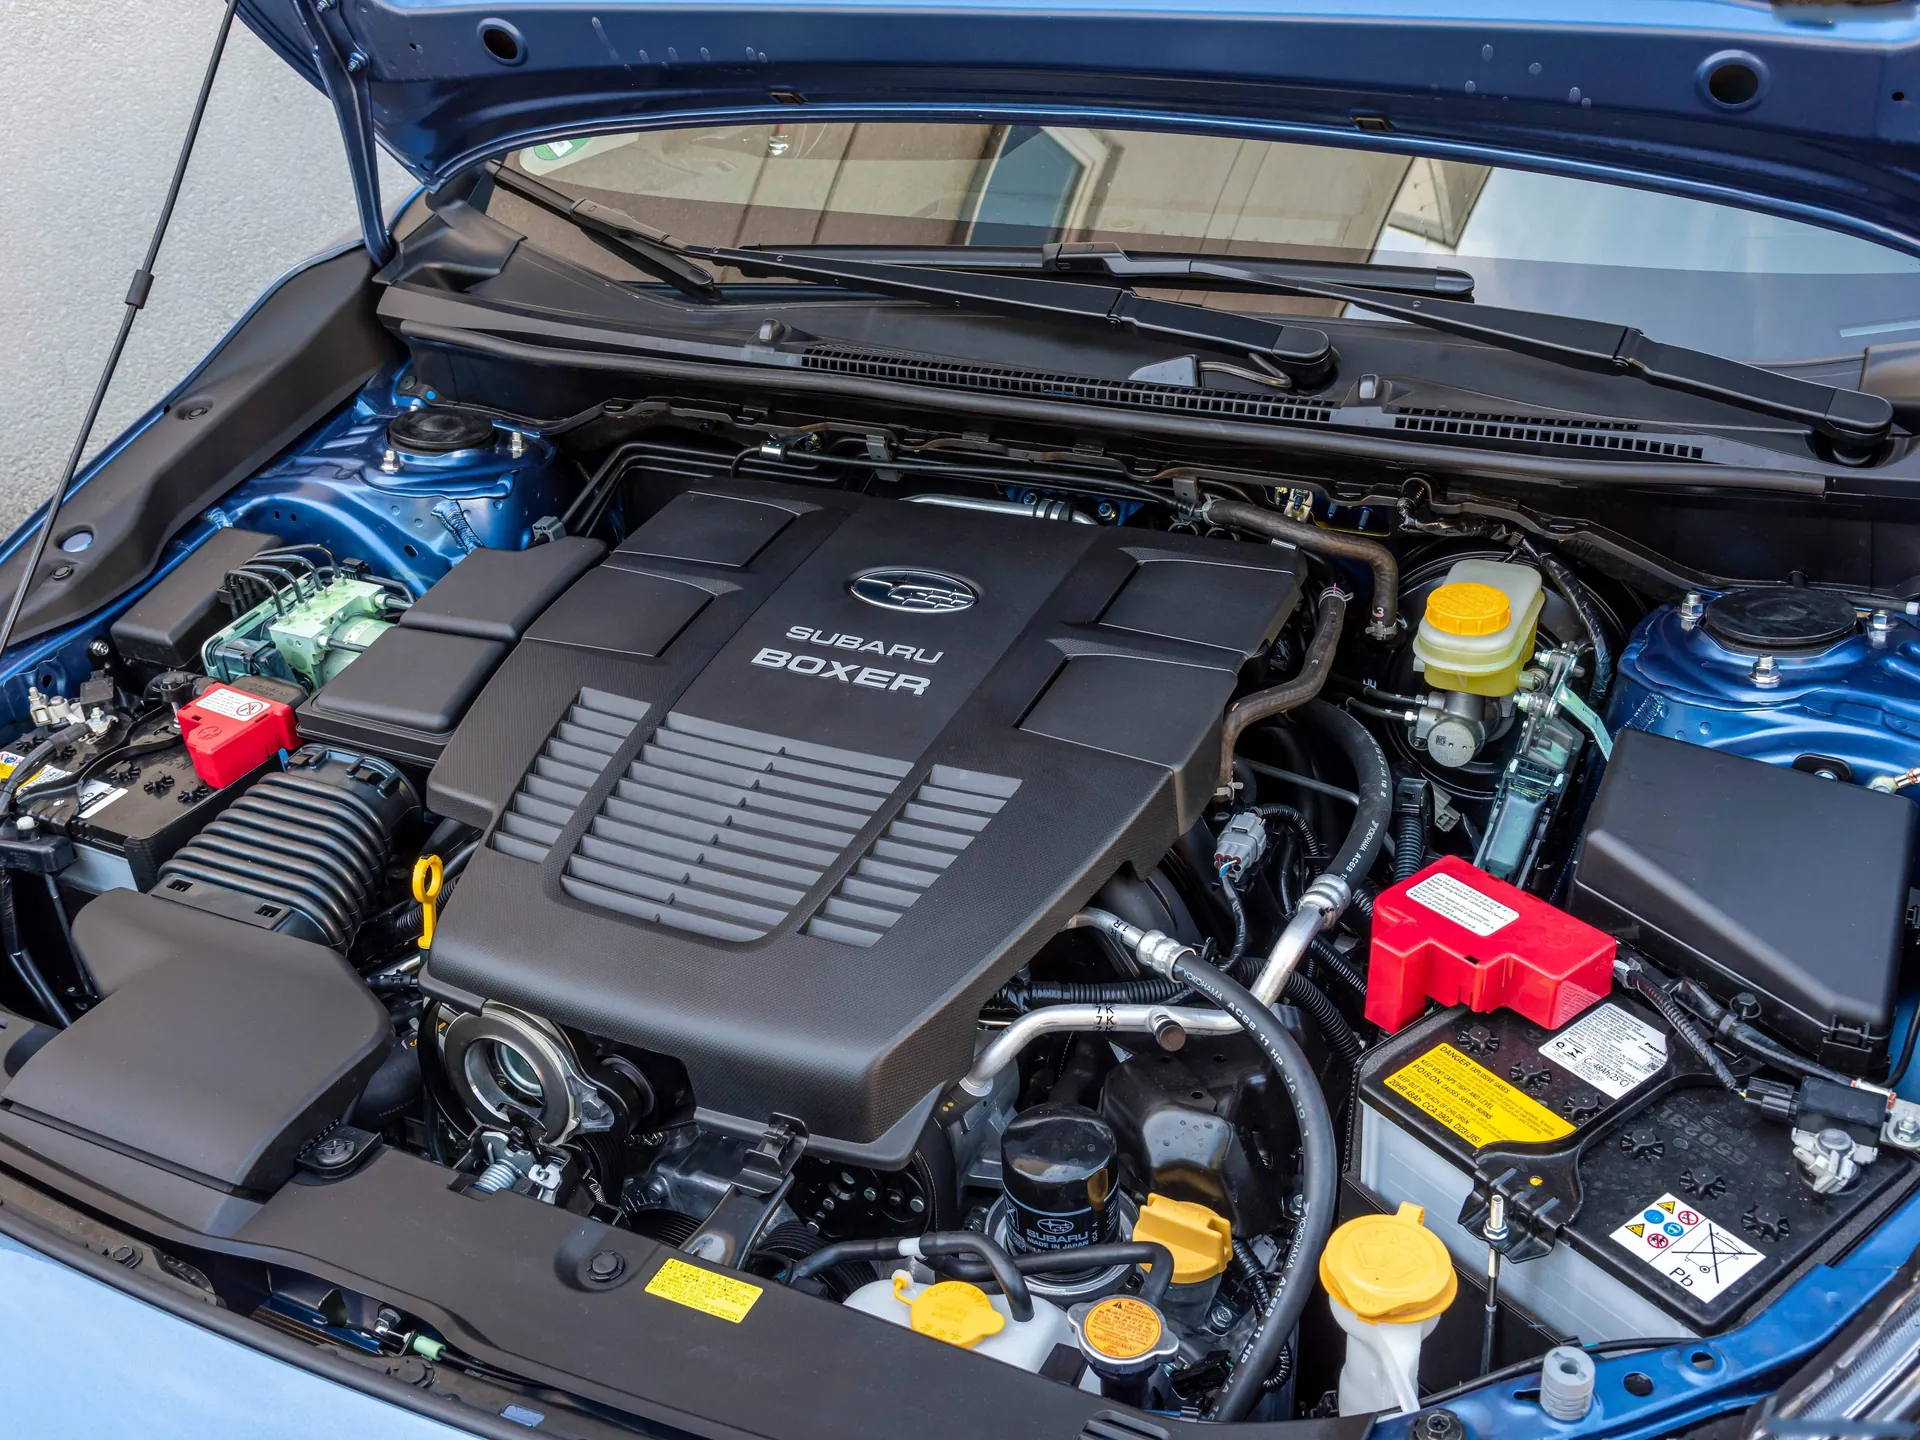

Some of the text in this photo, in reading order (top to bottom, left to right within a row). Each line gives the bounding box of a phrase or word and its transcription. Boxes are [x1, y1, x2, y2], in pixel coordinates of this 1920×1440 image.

[785, 625, 944, 664] SUBARU
[751, 648, 932, 696] BOXER
[1359, 825, 1377, 852] YOKOHAMA
[1345, 852, 1362, 873] AC6B
[1182, 969, 1224, 1001] YOKOHAMA
[1227, 1001, 1258, 1031] AC6B
[1259, 1033, 1271, 1047] 11
[1270, 1048, 1284, 1067] HP
[1284, 1073, 1297, 1094] JA
[1419, 1059, 1494, 1109] KEEP VENT CAPS TIGHT AND LEVEL
[1438, 1045, 1471, 1067] DANGER
[1469, 1066, 1495, 1083] EXPLOSIVE
[1492, 1081, 1510, 1093] GASES
[1387, 1078, 1407, 1092] 20HR
[1403, 1089, 1423, 1103] 48Ah
[1420, 1101, 1438, 1113] CCA
[1434, 1110, 1454, 1124] 390A
[1396, 1073, 1410, 1083] KEEP
[1408, 1082, 1420, 1090] OUT
[1424, 1093, 1441, 1105] REACH
[1444, 1106, 1470, 1124] CHILDREN
[1411, 1063, 1494, 1120] POISON CAUSES SEVERE BURNS
[1026, 1228, 1088, 1243] SUBARU
[1027, 1237, 1049, 1249] MADE
[1051, 1241, 1060, 1249] IN
[1062, 1239, 1089, 1249] JAPAN
[1286, 1216, 1308, 1269] YOKOHAMA
[1264, 1276, 1287, 1318] AC6B
[1668, 1266, 1694, 1287] Pb
[1254, 1324, 1264, 1338] 11
[1241, 1343, 1255, 1364] HP
